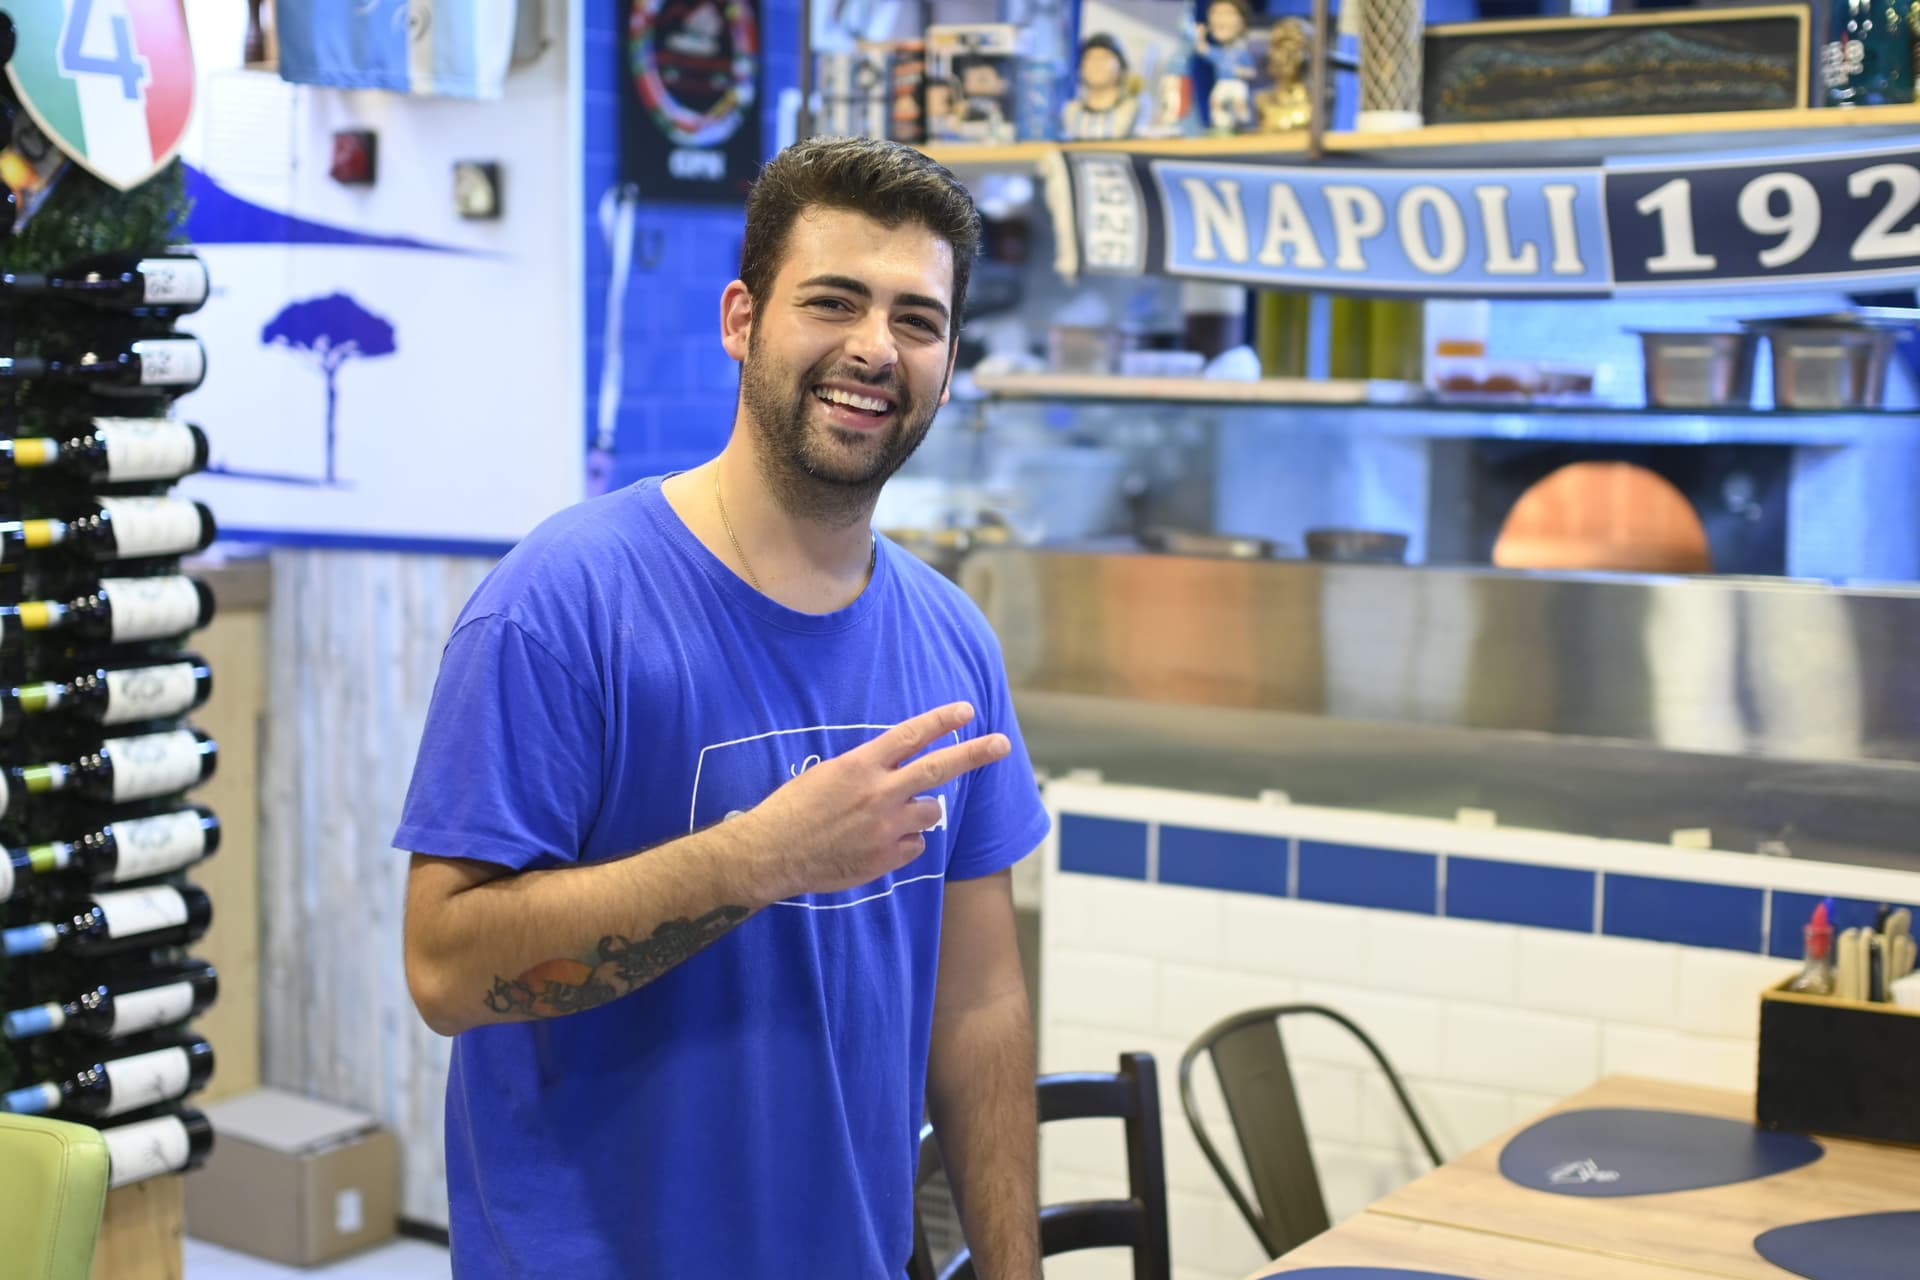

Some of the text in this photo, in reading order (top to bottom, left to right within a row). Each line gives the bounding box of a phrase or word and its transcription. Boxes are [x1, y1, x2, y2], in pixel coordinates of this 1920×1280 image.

[61, 0, 145, 101] 4
[1093, 166, 1130, 260] 1926
[1180, 177, 1586, 275] NAPOLI
